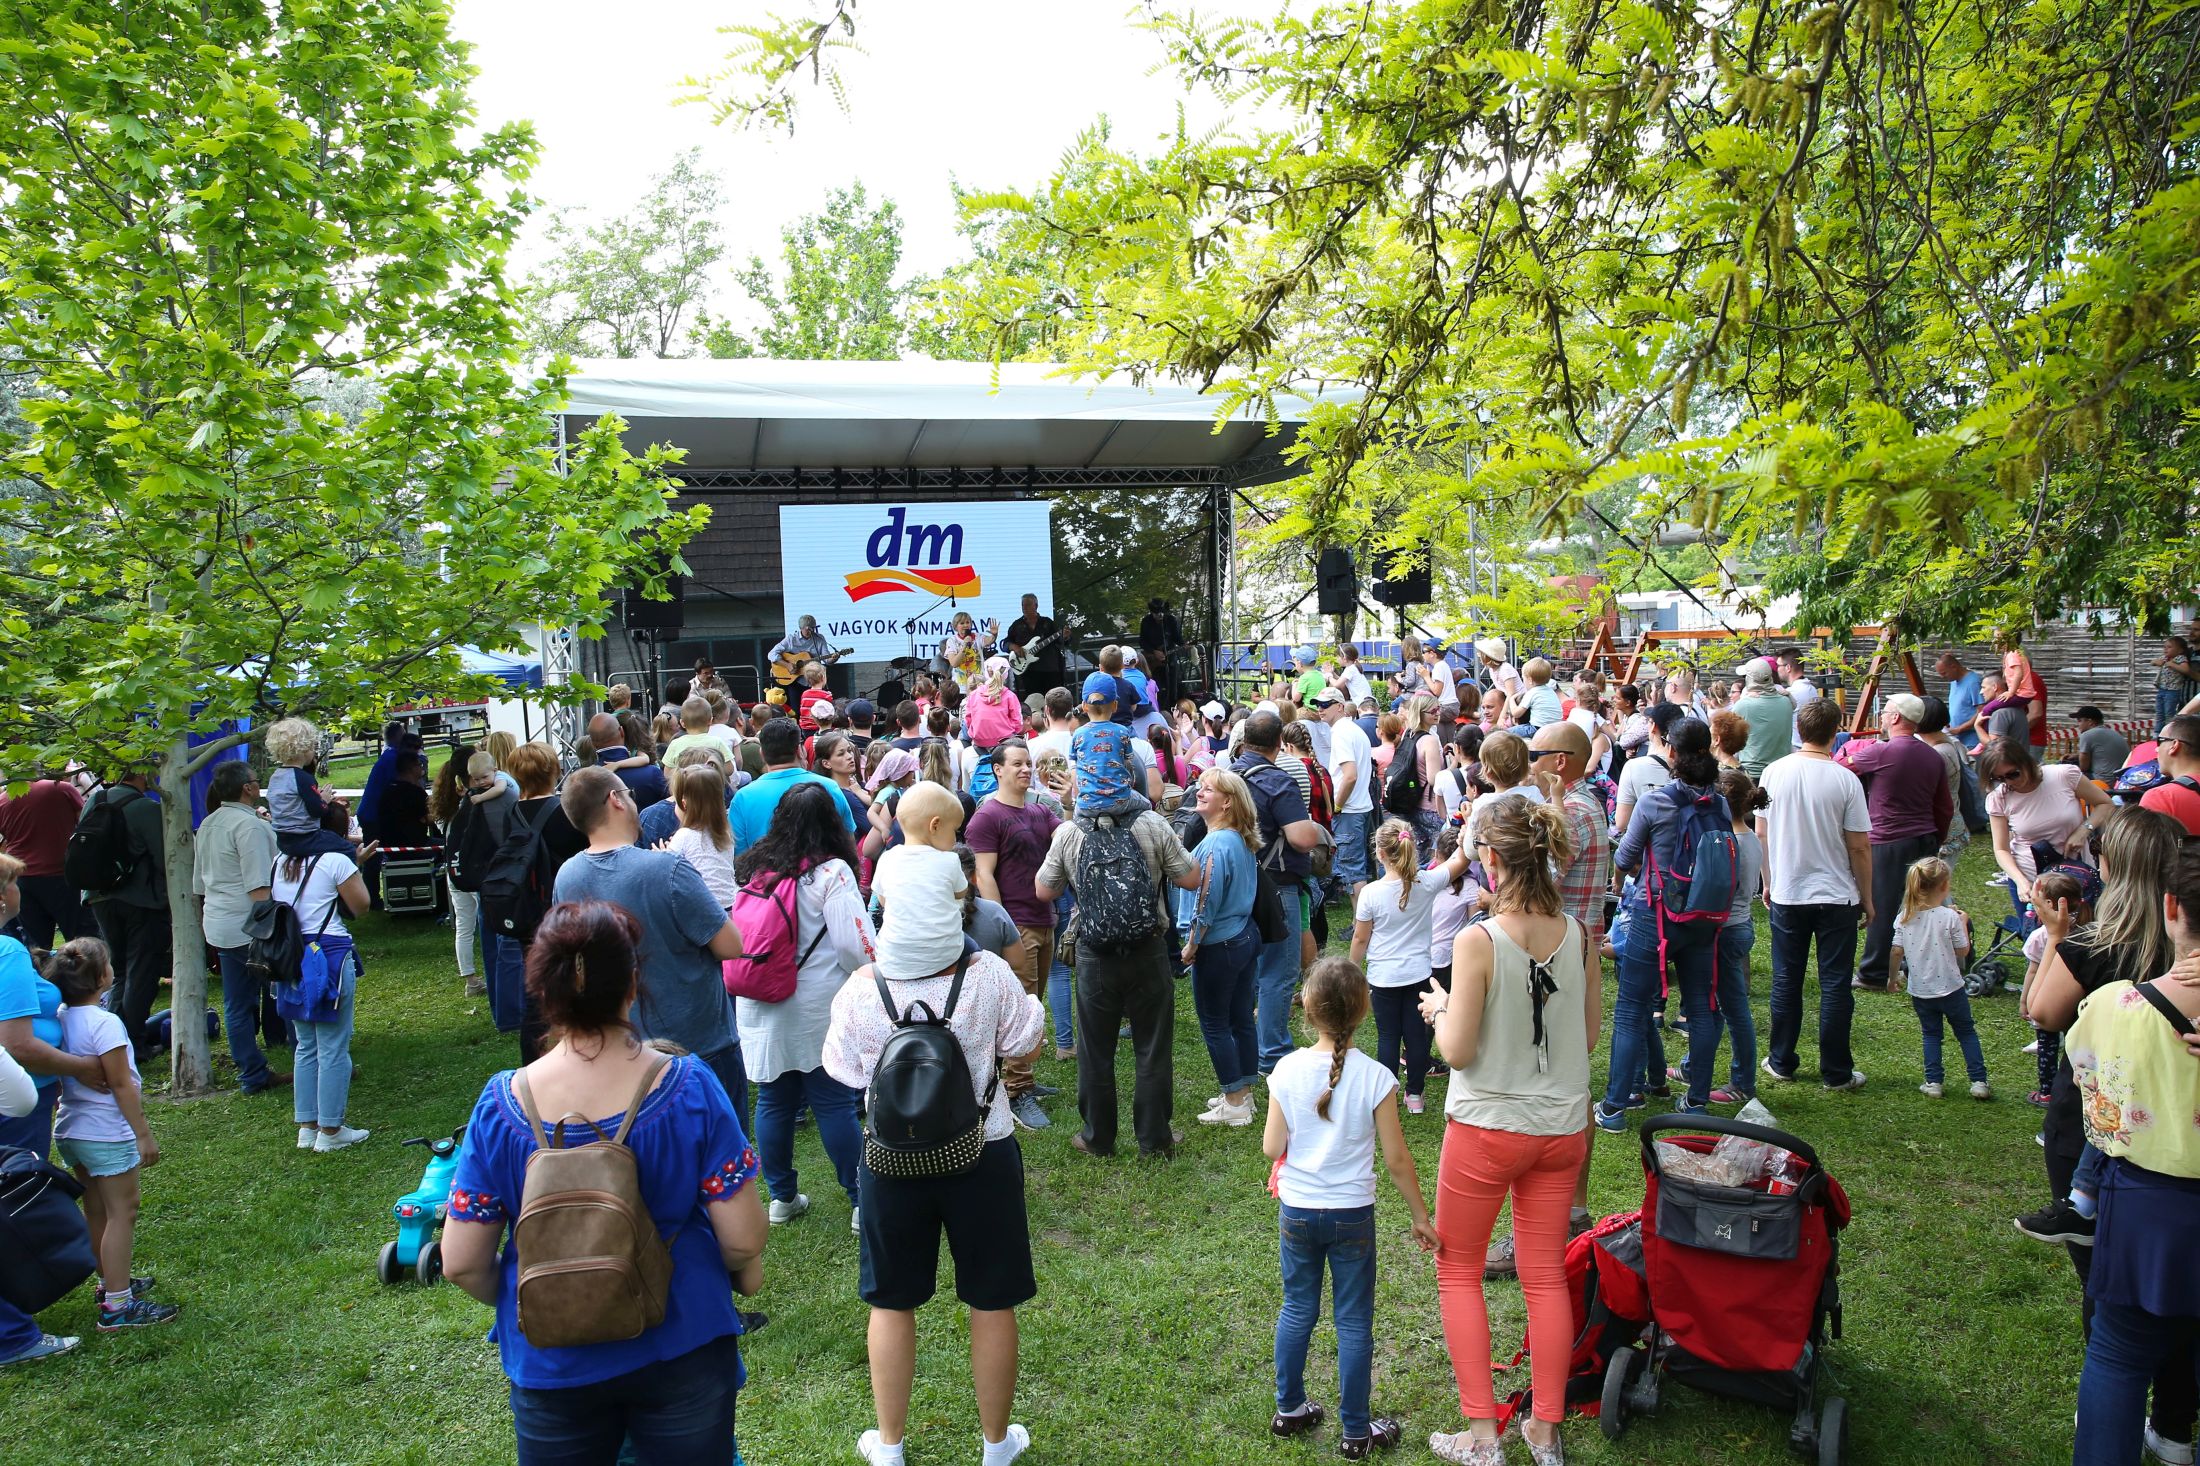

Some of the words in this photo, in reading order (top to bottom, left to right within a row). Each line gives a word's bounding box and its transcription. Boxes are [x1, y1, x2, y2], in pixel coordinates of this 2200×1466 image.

[866, 507, 963, 568] dm
[828, 619, 898, 637] VAGYOK
[905, 617, 992, 635] ÖNMAAM
[450, 851, 462, 877] FILA
